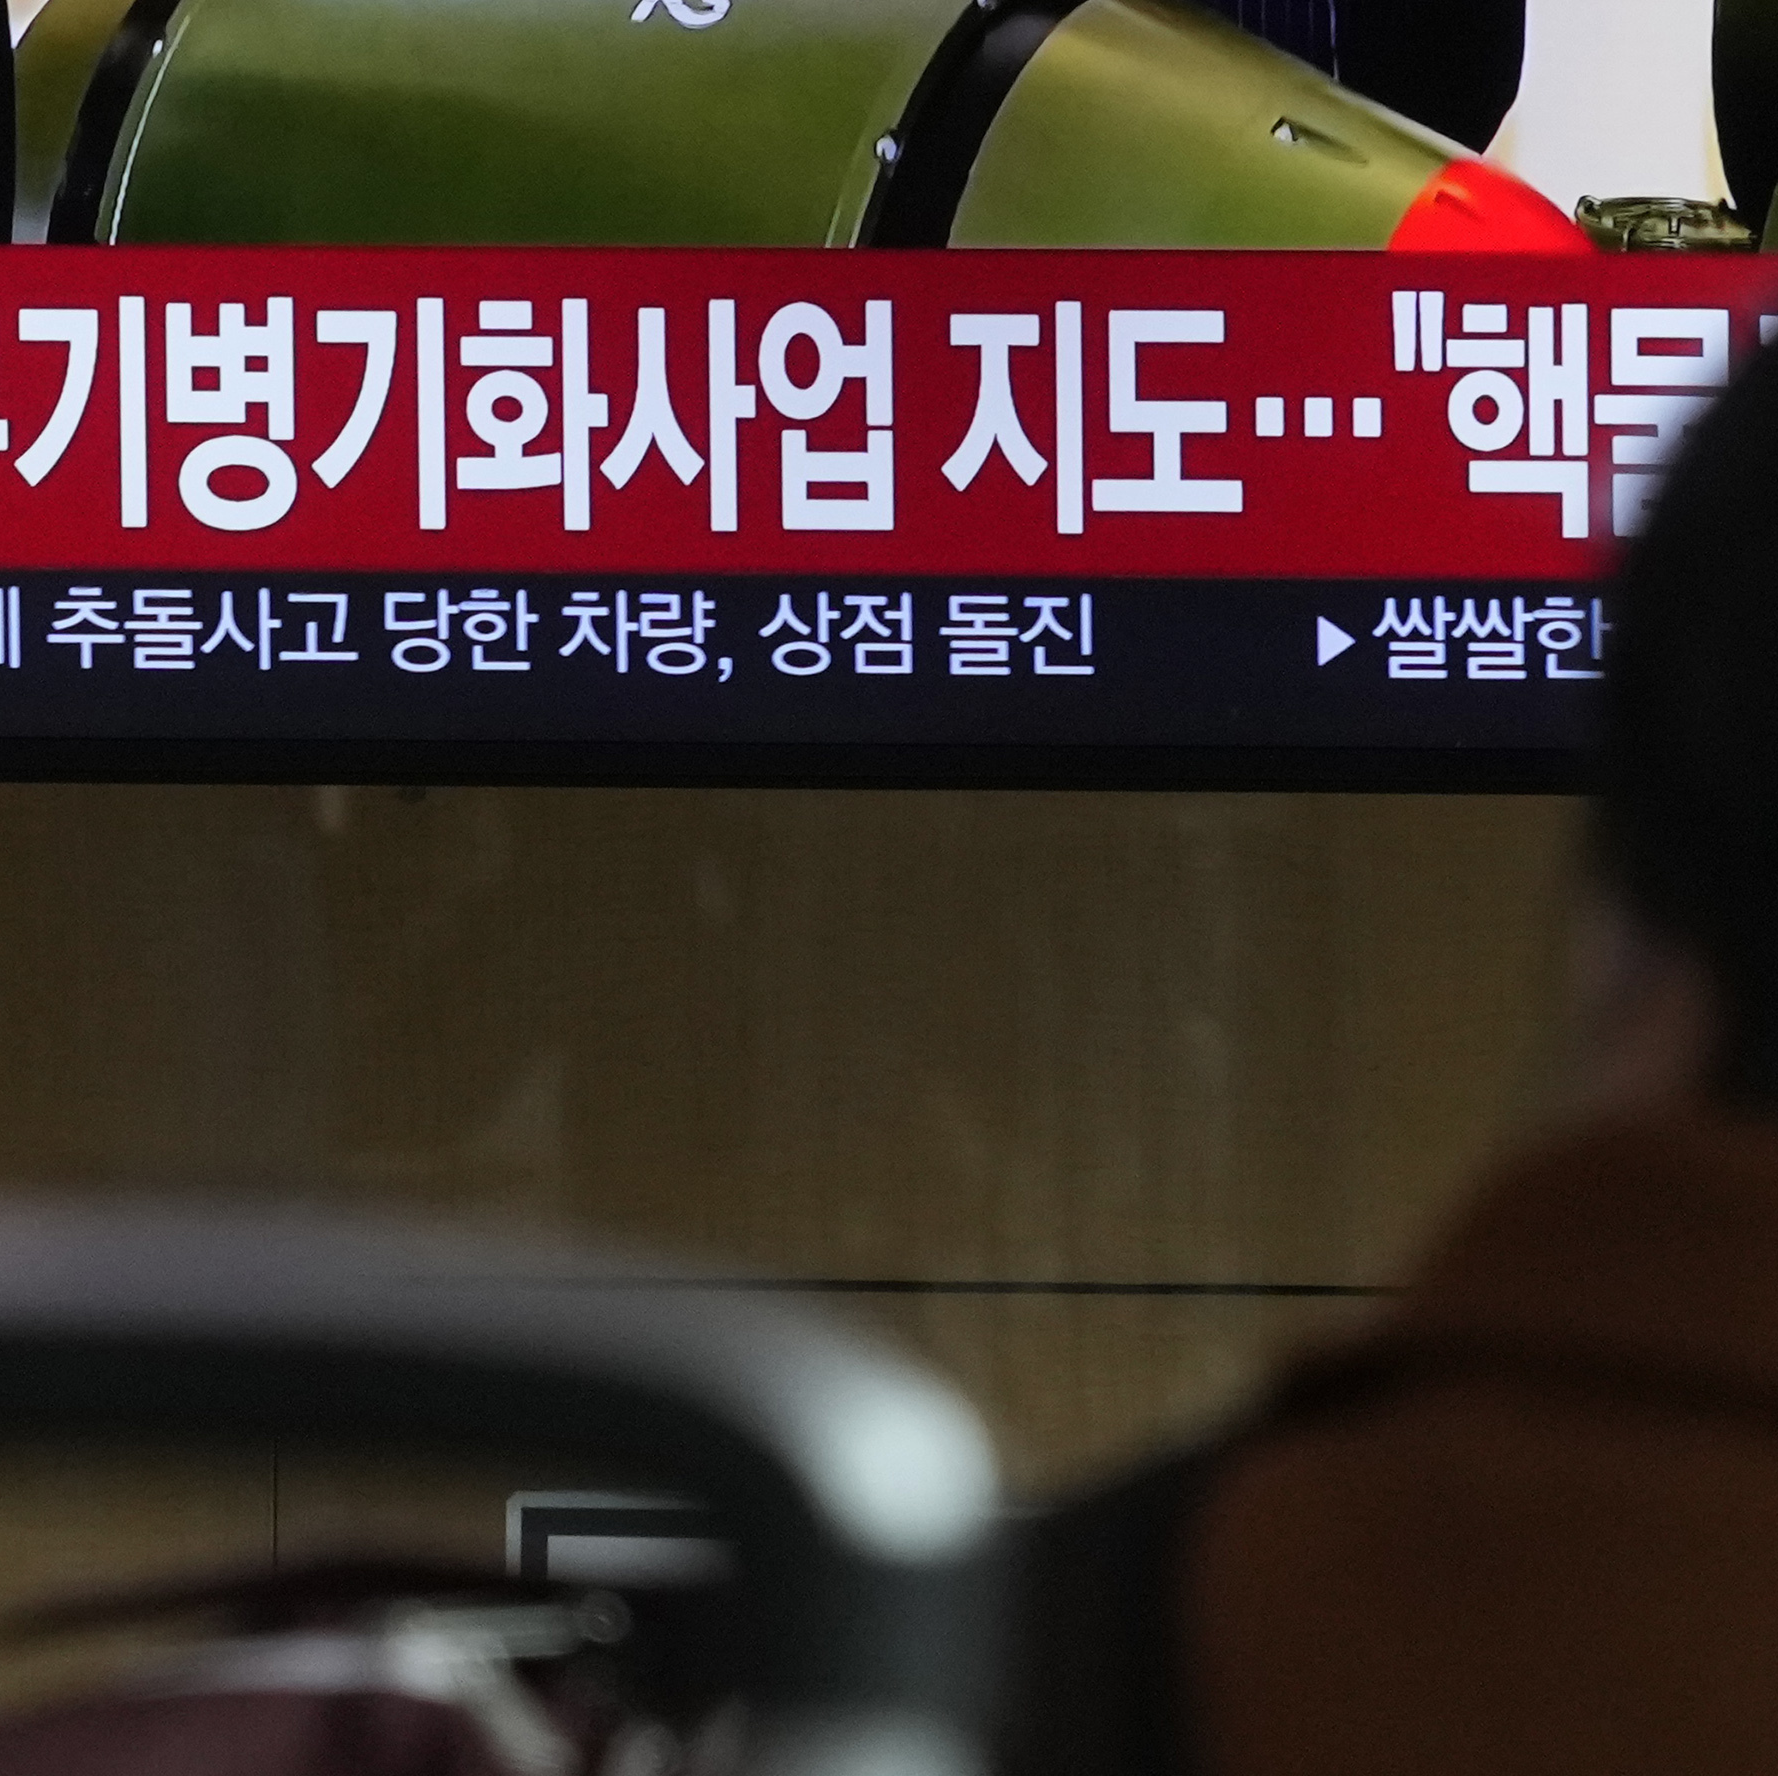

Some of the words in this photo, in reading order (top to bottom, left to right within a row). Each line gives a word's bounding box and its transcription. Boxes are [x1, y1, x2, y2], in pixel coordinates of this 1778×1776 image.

[46, 587, 359, 671] 추돌사고
[383, 588, 540, 673] 당한
[559, 589, 734, 682] 차량,
[759, 591, 914, 676] 상점
[939, 593, 1095, 676] 돌진
